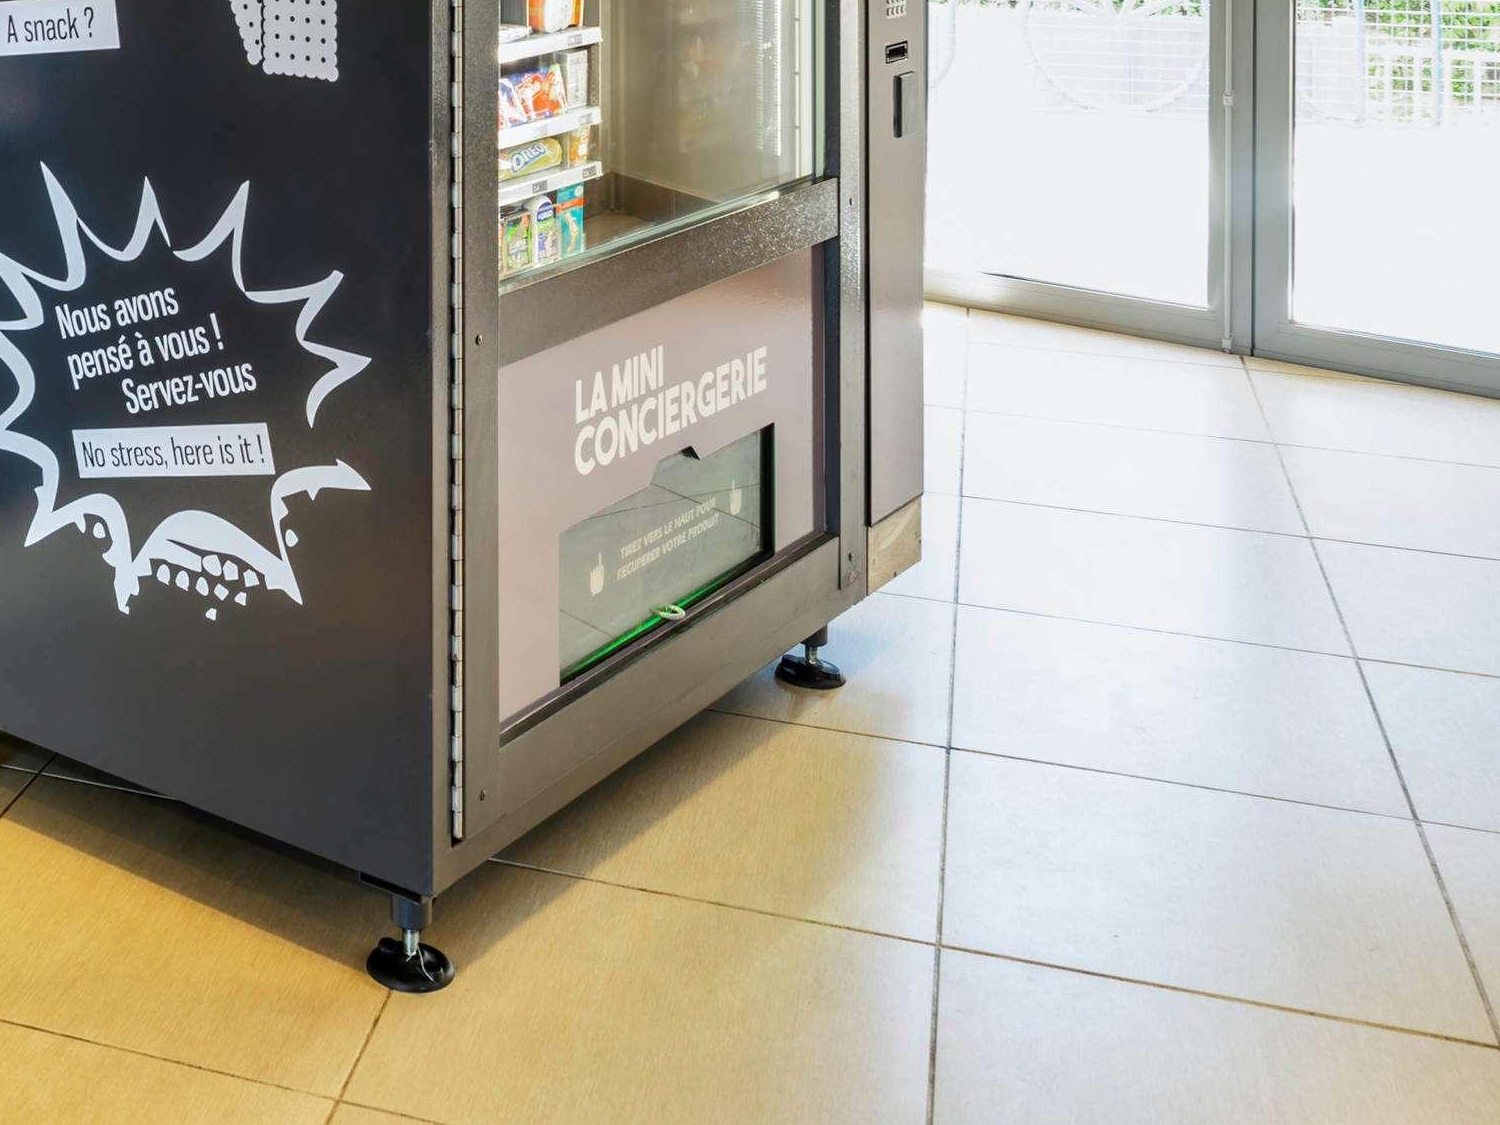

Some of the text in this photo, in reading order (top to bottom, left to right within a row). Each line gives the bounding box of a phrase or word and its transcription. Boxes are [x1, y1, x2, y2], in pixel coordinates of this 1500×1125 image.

[7, 15, 18, 44] A
[23, 9, 79, 43] snack
[512, 143, 546, 174] OREO
[54, 287, 179, 340] Nous avons
[67, 334, 134, 391] pensé
[134, 331, 155, 367] à
[155, 326, 211, 362] vous
[575, 345, 664, 424] LA MINI
[121, 362, 257, 415] Servez-vous
[574, 345, 767, 475] CONCIERGERIE
[81, 441, 106, 468] No
[111, 441, 168, 469] stress,
[170, 437, 214, 466] here
[217, 435, 235, 465] is
[237, 434, 255, 465] it
[663, 520, 674, 535] LE
